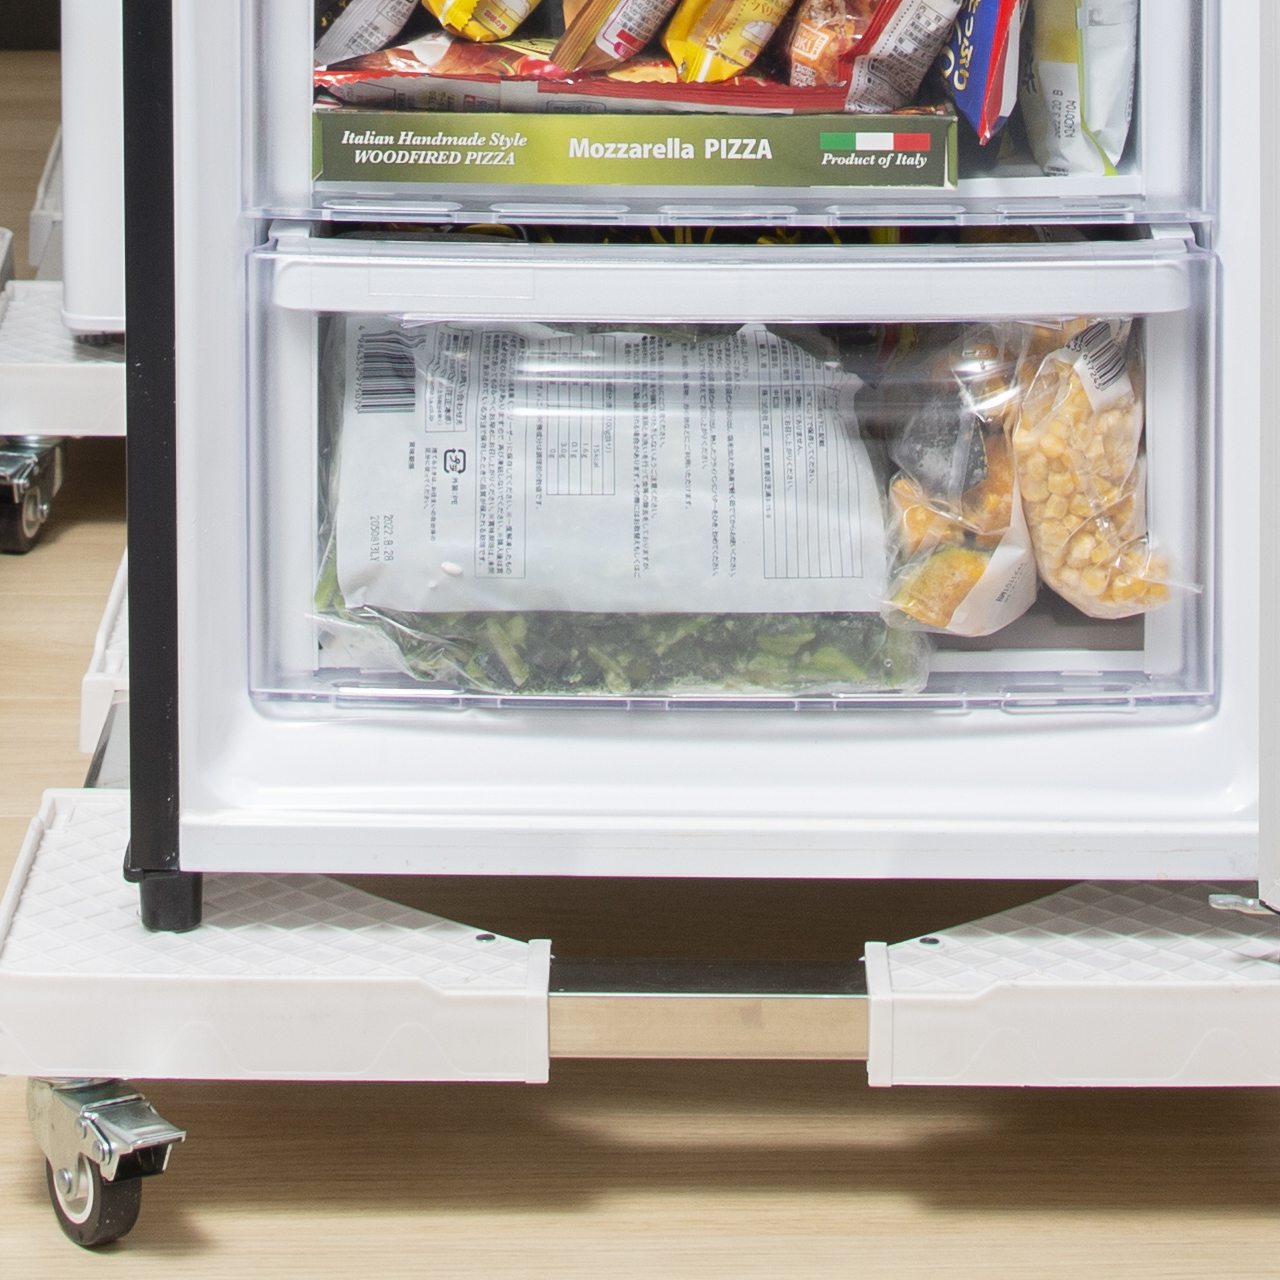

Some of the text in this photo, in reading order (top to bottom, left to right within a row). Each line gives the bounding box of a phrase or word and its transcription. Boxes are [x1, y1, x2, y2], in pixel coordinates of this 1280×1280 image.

[342, 130, 528, 149] Italian Handmade Style
[353, 149, 517, 167] WOODFIRED PIZZA
[568, 137, 773, 161] Mozzarella PIZZA
[821, 152, 929, 168] Product of Italy
[407, 440, 416, 471] 賞味期限
[548, 448, 557, 459] 0g
[559, 441, 568, 459] 3.0g
[570, 441, 579, 459] 0.1g
[581, 441, 590, 459] 1.6g
[593, 443, 601, 469] 15kcal
[369, 514, 381, 563] 2050813LY
[383, 513, 394, 562] 2022.8.28
